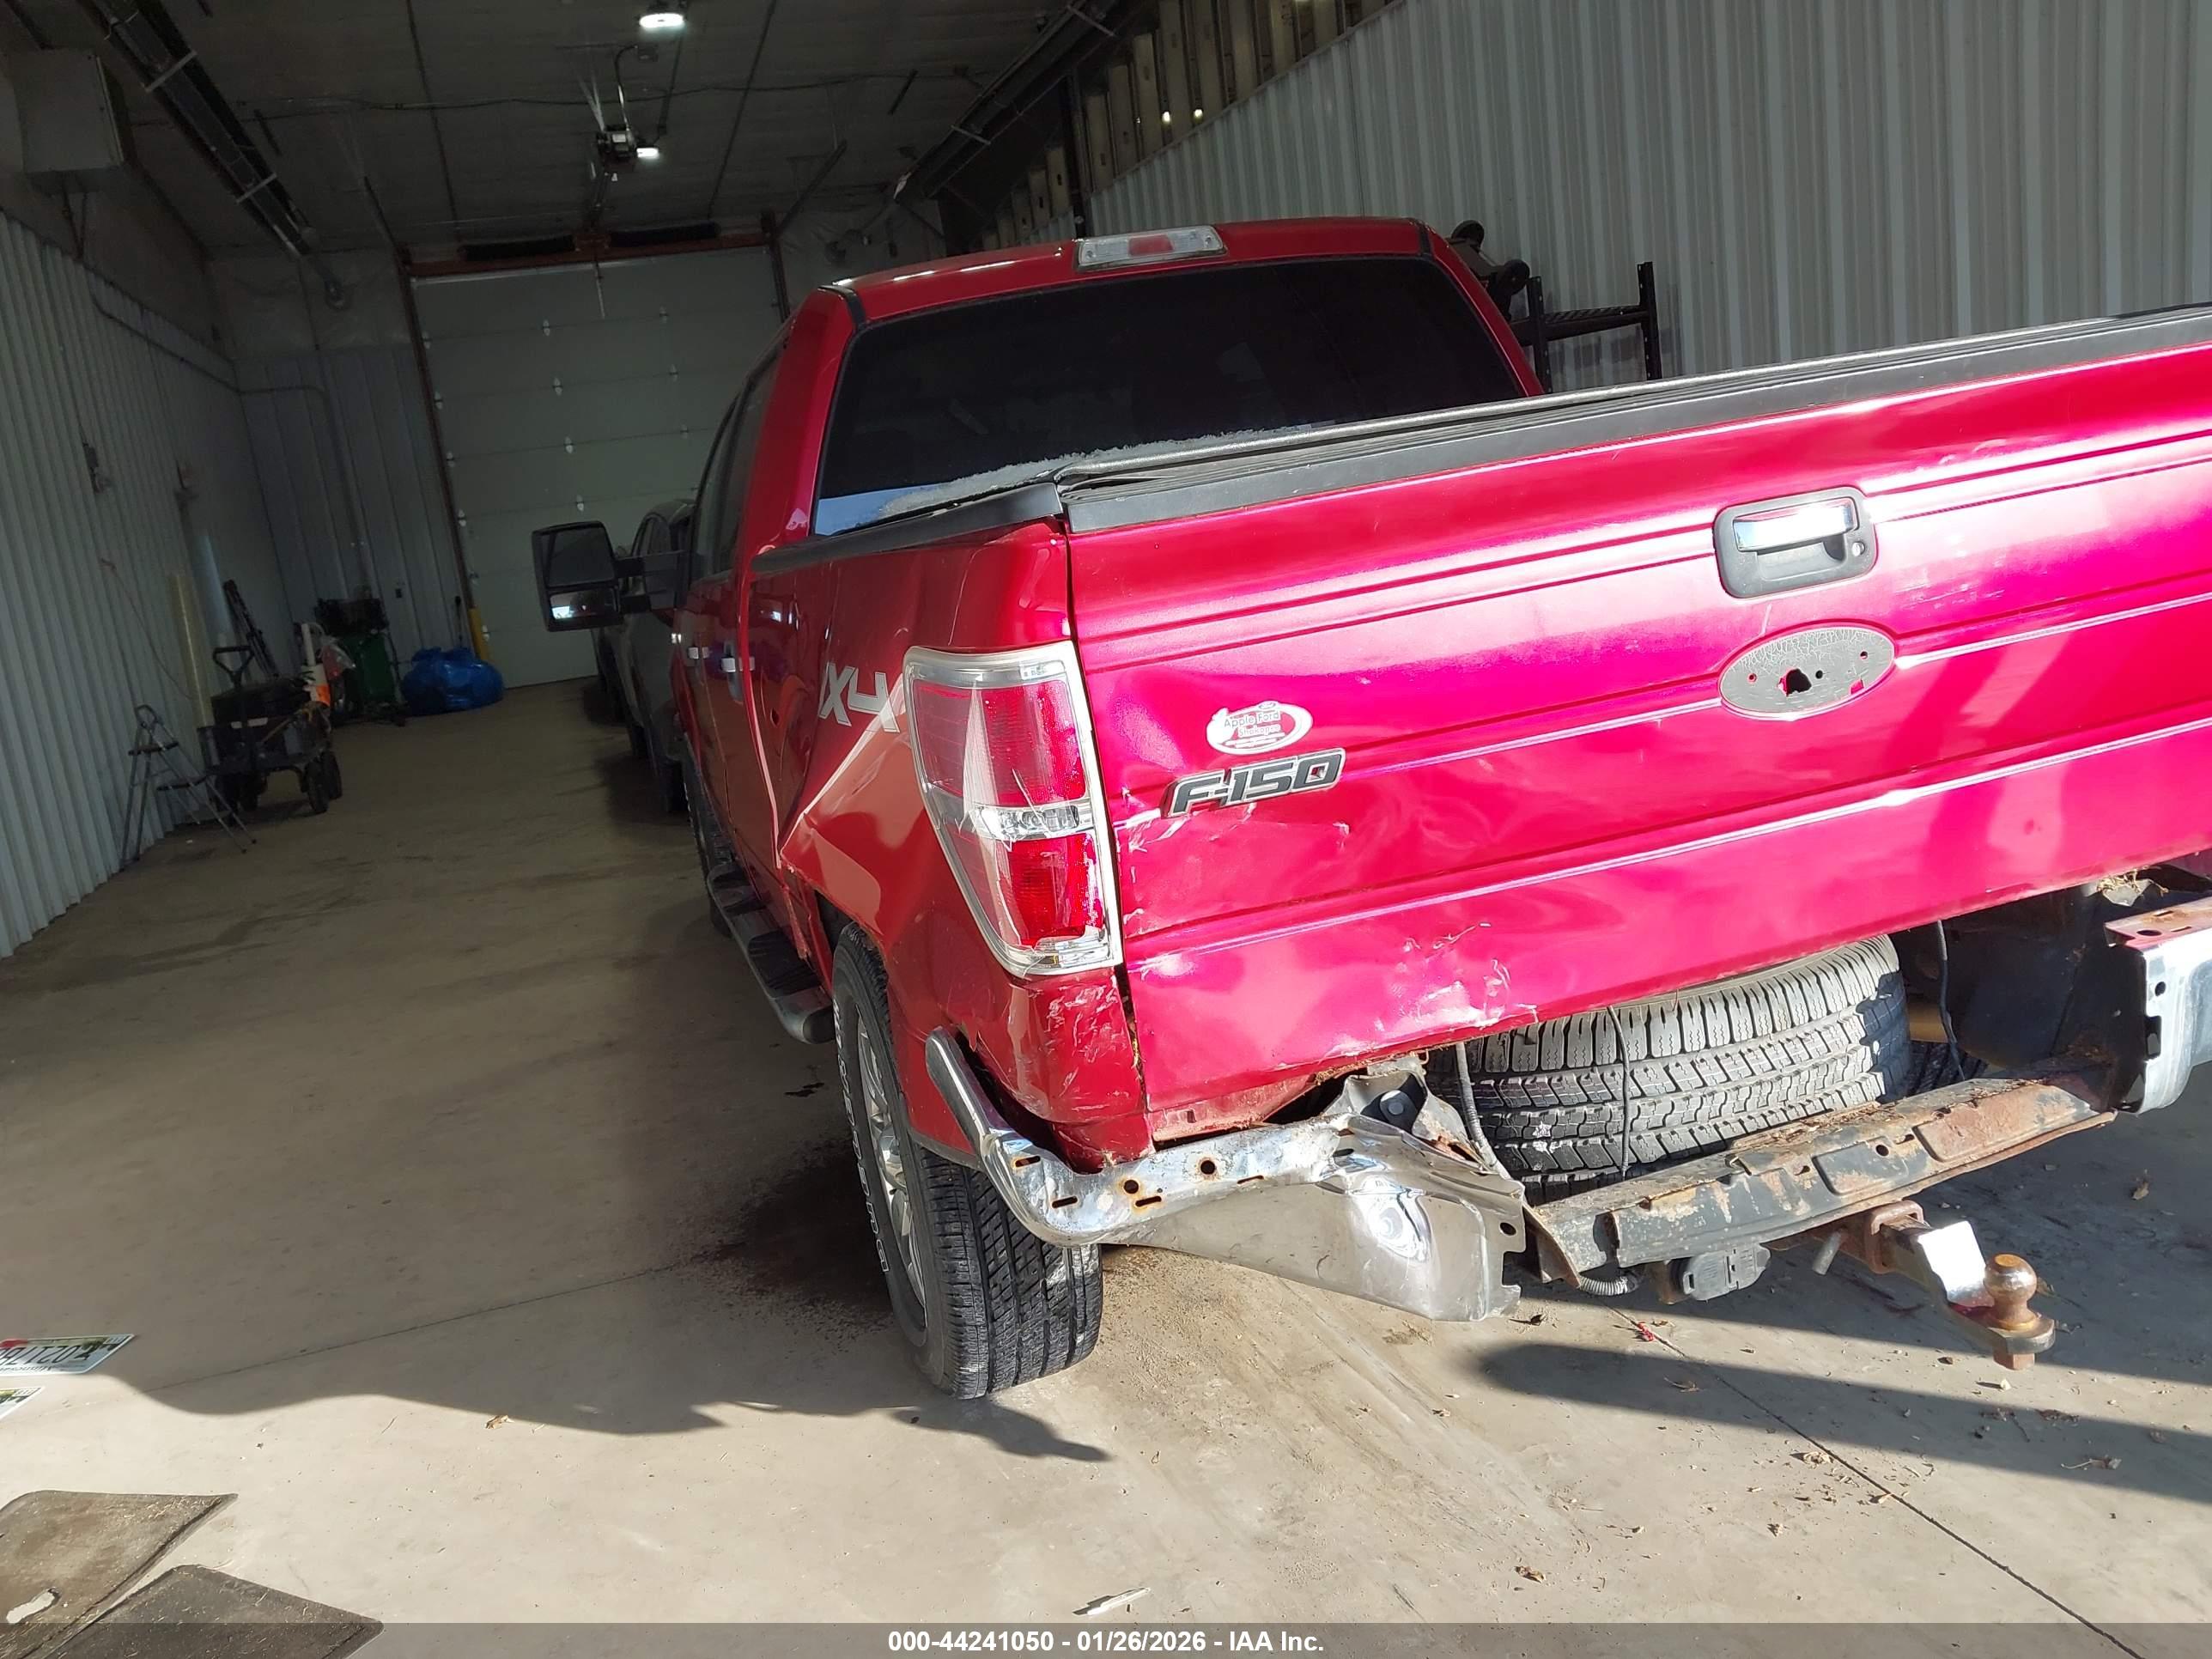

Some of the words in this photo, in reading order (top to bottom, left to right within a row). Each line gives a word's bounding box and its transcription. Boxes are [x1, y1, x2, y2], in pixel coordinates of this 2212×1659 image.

[1224, 715, 1255, 728] Apple
[1258, 710, 1279, 721] Ford
[1169, 748, 1346, 817] F-150
